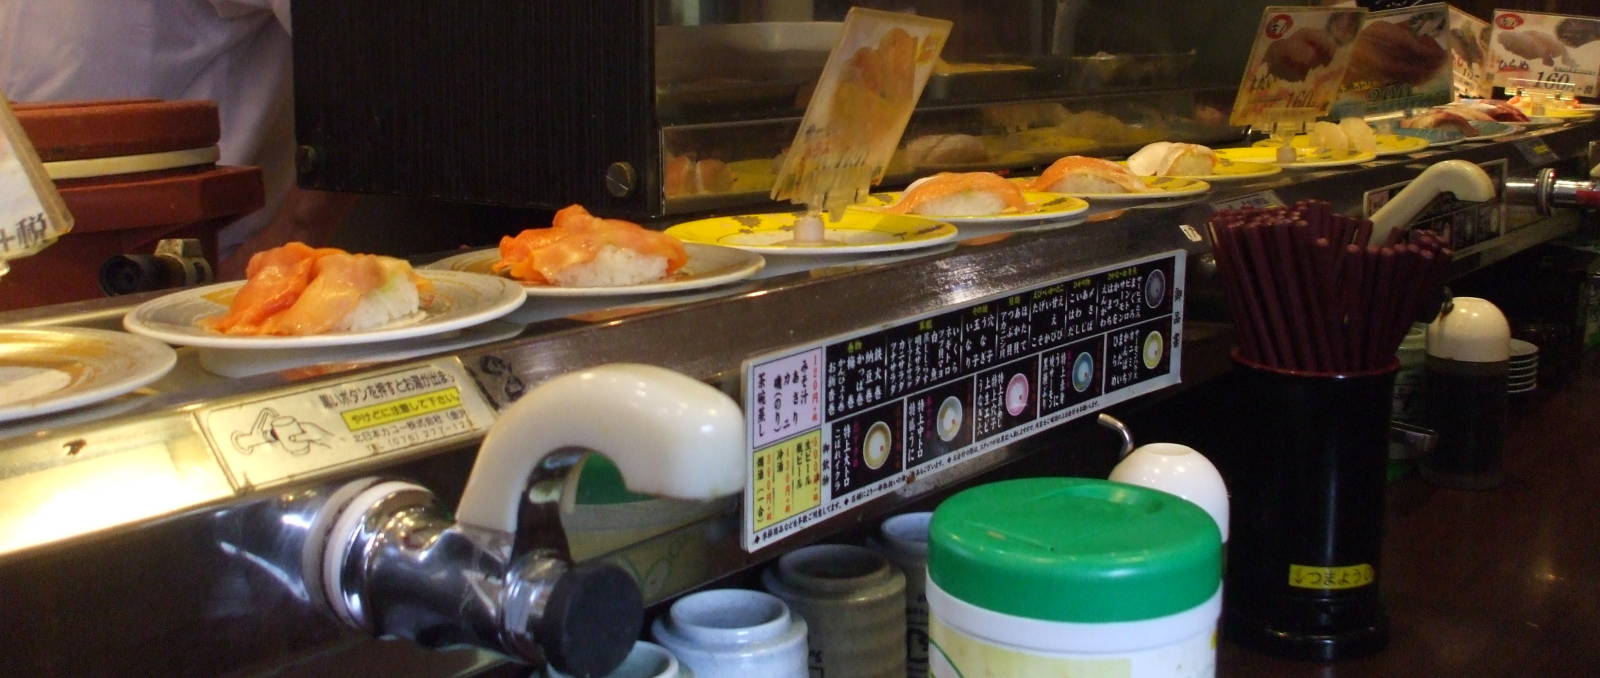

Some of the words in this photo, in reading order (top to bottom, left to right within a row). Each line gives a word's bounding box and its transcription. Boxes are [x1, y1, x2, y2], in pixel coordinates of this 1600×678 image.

[792, 370, 800, 424] あさり
[800, 360, 809, 405] みそ汁
[843, 423, 852, 487] 特上大トロ
